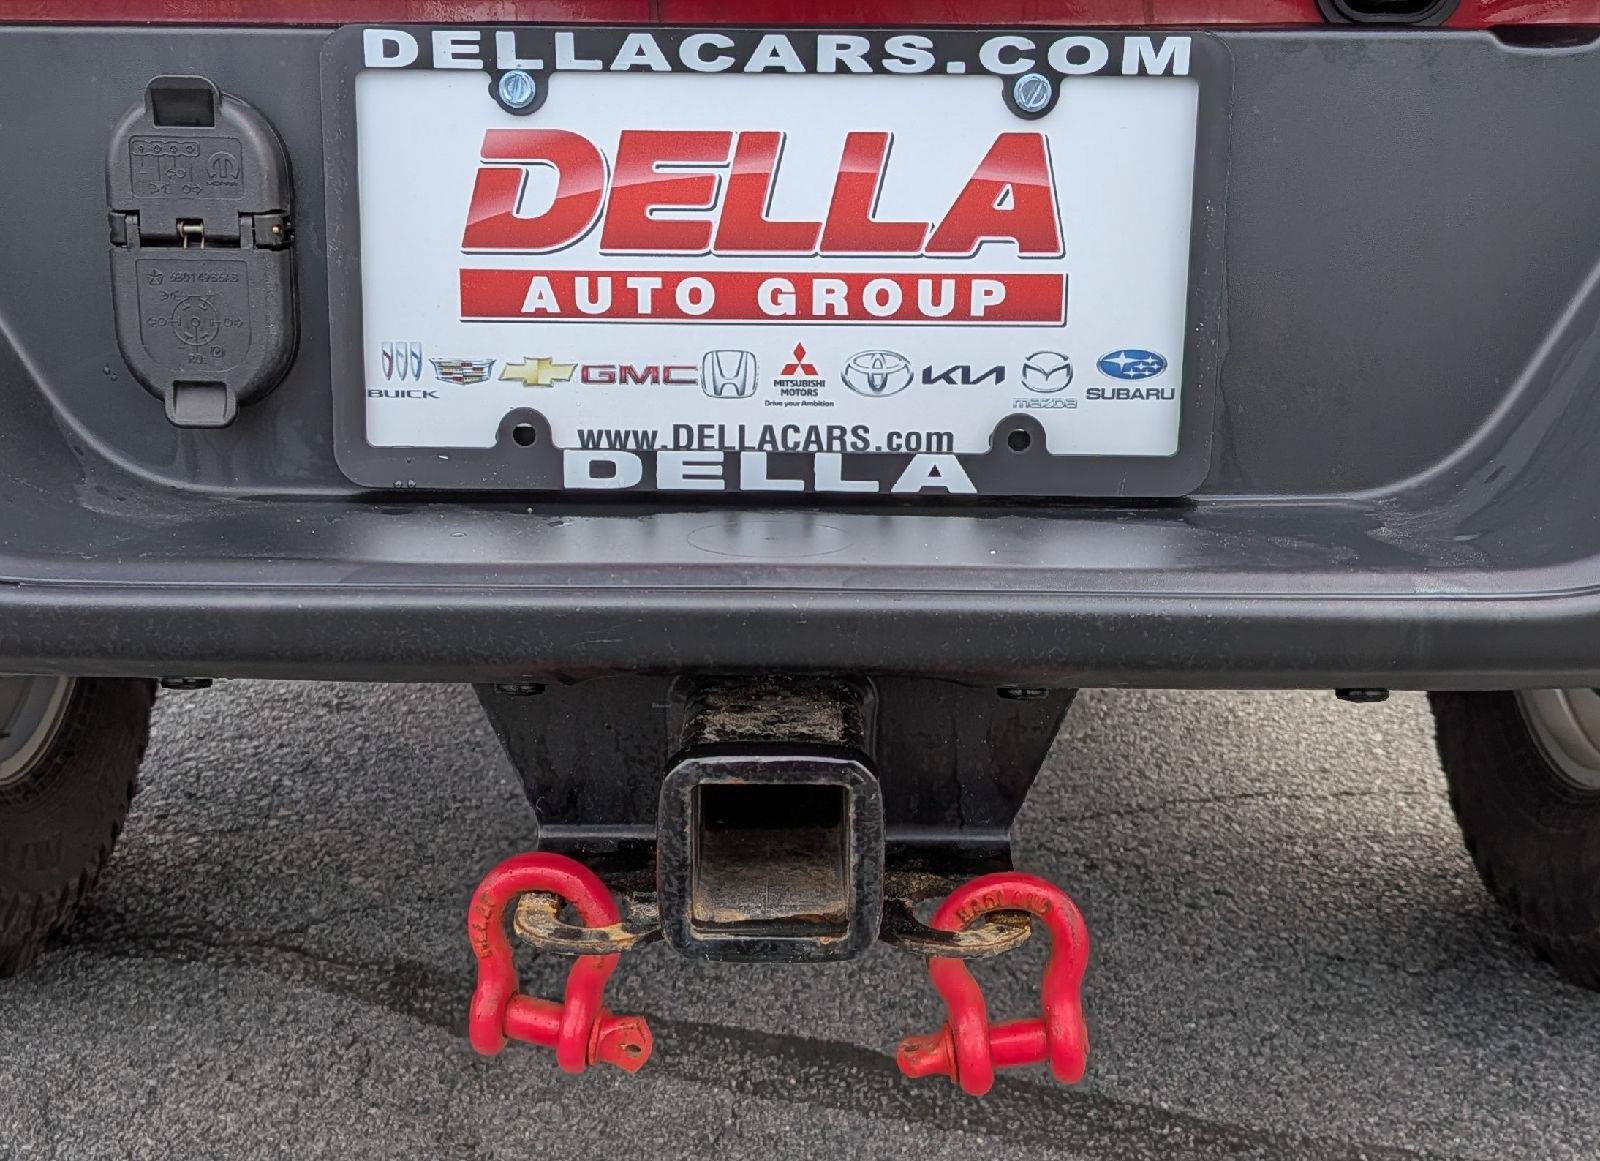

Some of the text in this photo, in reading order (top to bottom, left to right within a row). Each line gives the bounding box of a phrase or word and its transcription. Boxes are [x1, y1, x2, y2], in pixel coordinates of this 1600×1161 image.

[363, 29, 1192, 76] DELLACARS.COM
[461, 129, 1065, 259] DELLA
[521, 276, 1007, 317] AUTO GROUP
[580, 364, 698, 386] GMC
[773, 379, 826, 388] MITSUBISHI
[367, 388, 440, 400] BUICK
[780, 388, 819, 397] MOTORS
[1086, 387, 1175, 401] SUBARU
[577, 423, 955, 453] www.DELLACARS.com
[563, 449, 977, 494] DELLA
